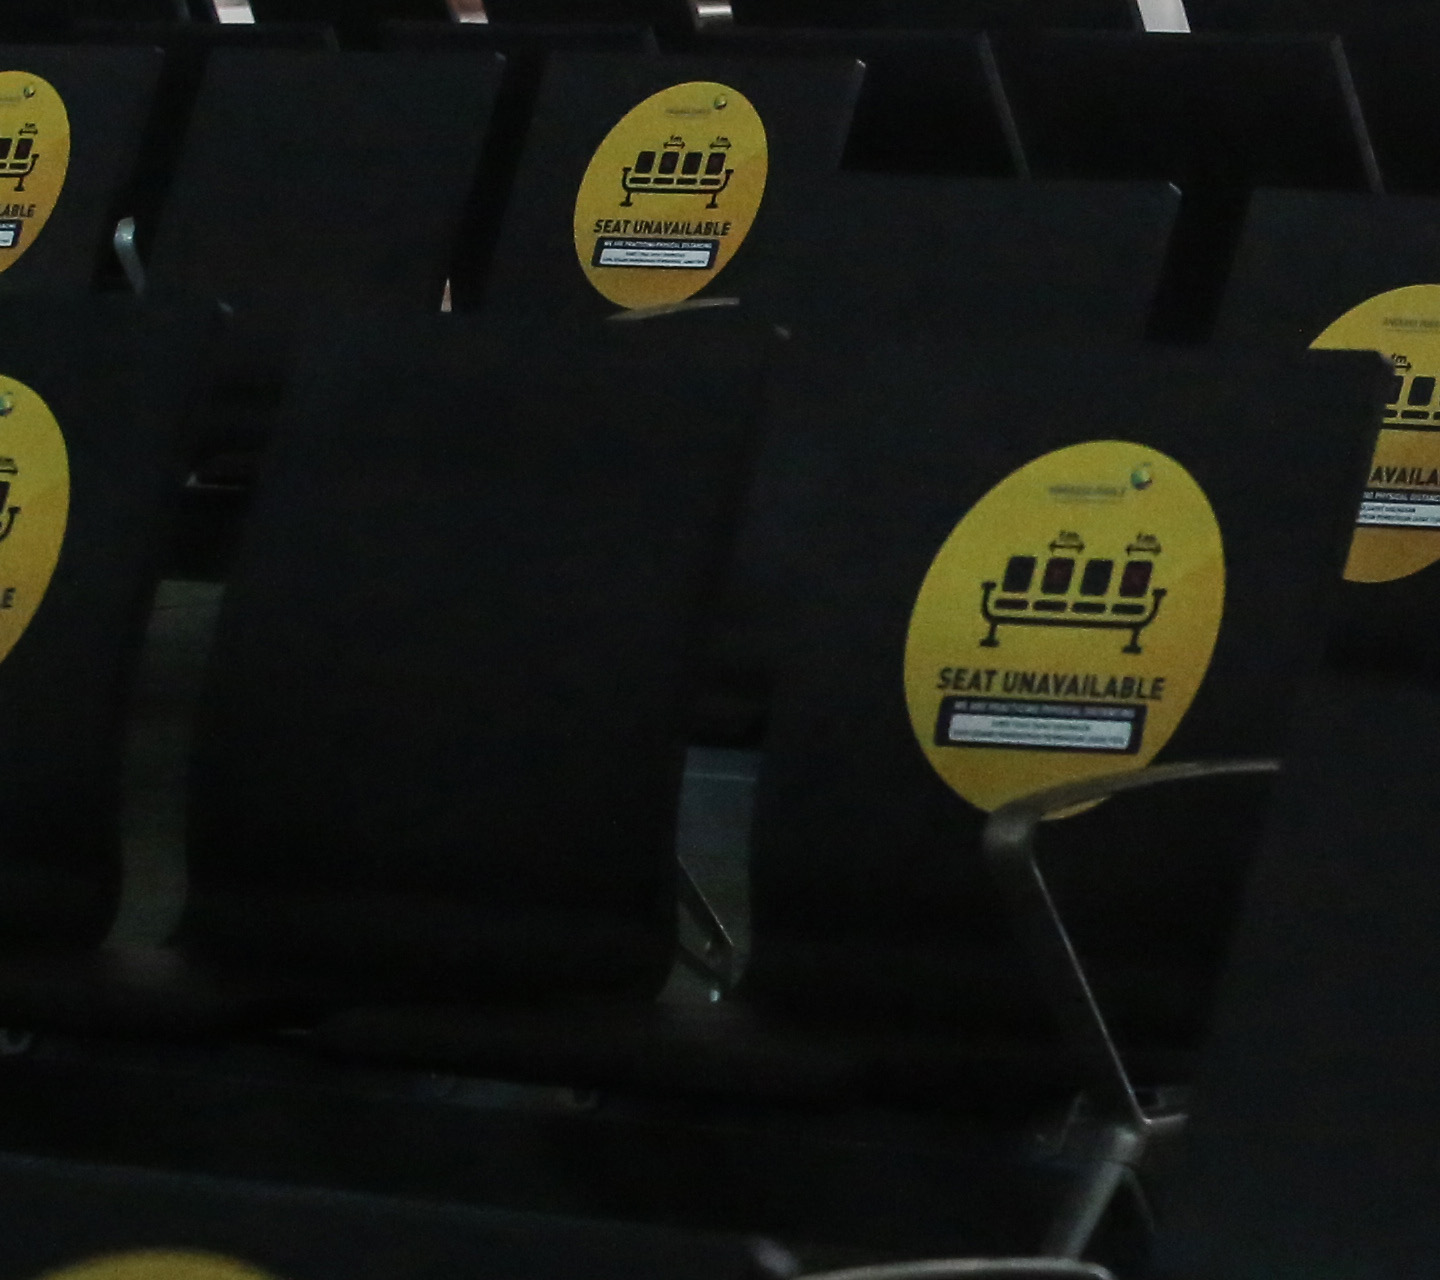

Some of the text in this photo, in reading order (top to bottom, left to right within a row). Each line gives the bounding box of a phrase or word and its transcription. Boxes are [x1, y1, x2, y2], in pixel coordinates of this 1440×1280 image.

[593, 219, 732, 236] SEAT UNAVAILABLE
[936, 667, 1166, 700] SEAT UNAVAILABLE
